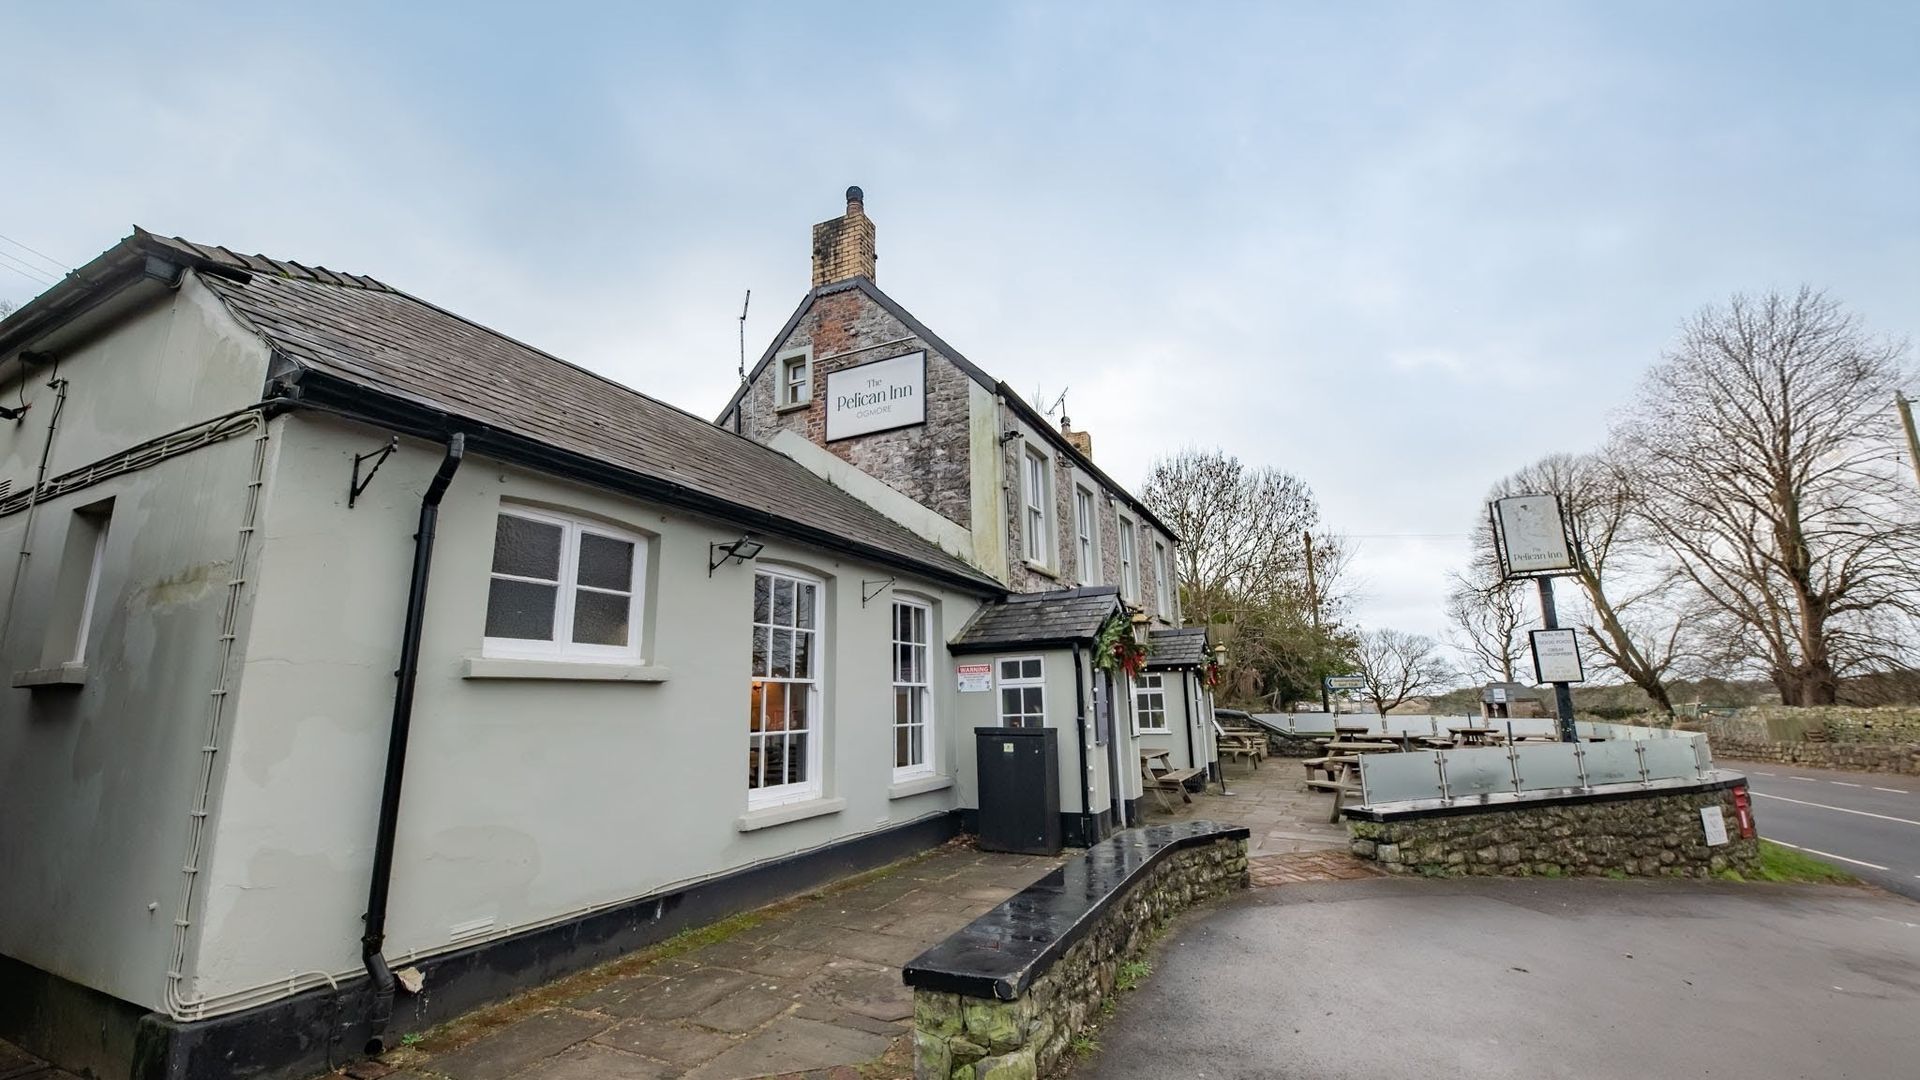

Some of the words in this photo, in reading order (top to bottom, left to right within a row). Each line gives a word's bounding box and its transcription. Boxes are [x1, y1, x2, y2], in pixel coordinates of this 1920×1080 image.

[867, 379, 882, 388] The
[837, 390, 886, 412] Pelican
[890, 384, 912, 400] Inn
[856, 405, 892, 419] OGMORE
[1513, 552, 1546, 561] Pelican
[1547, 551, 1563, 559] Inn
